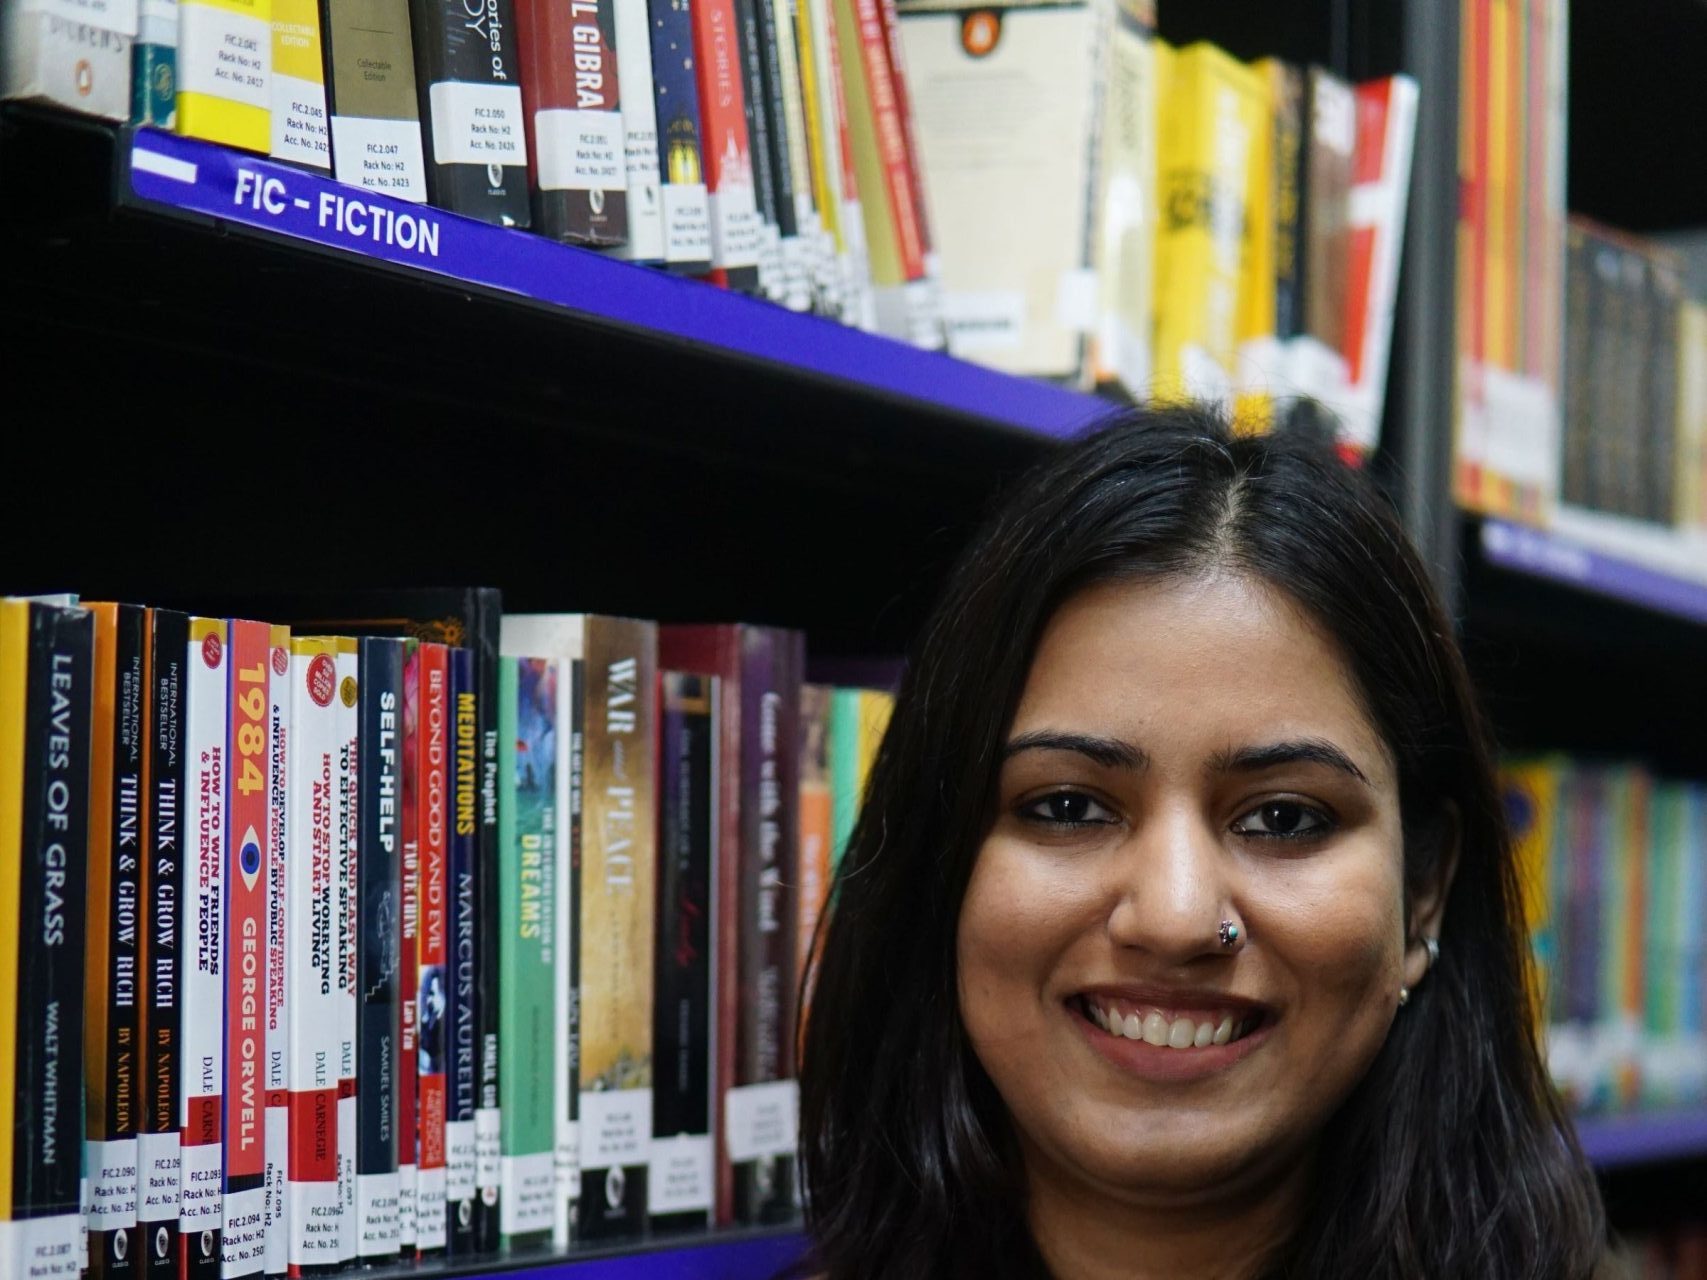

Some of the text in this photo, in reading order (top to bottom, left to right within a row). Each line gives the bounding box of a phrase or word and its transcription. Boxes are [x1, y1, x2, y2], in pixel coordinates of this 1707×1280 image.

[492, 57, 507, 80] of
[572, 26, 604, 109] GIBRA
[234, 168, 285, 215] FIC
[318, 192, 440, 256] FICTION
[362, 176, 376, 186] Acc.
[378, 178, 390, 187] No.
[363, 160, 404, 171] Rack No: H2
[122, 672, 131, 745] BESTSELLER
[130, 656, 140, 763] INTERNATIONAL
[159, 678, 168, 751] BESTSELLER
[168, 662, 177, 768] INTERNATIONAL
[238, 663, 266, 795] 1984
[273, 705, 280, 714] &
[43, 654, 73, 945] LEAVES OF GRASS
[272, 716, 280, 806] INFLUENCE
[280, 766, 286, 788] TO
[380, 692, 395, 852] SELF-HELP
[428, 669, 442, 954] BEYOND GOOD AND EVIL
[457, 693, 476, 836] MEDITATIONS
[482, 730, 497, 825] The Prophet
[606, 658, 636, 898] WAR PEACE
[198, 751, 210, 971] & INFLUENCE PEOPLE
[210, 747, 221, 976] HOW TO WIN FRIENDS
[270, 868, 278, 887] BY
[278, 790, 286, 862] DEVELOP
[312, 781, 322, 968] AND START LIVING
[321, 753, 331, 996] HOW TO STOP WORRYING
[338, 744, 349, 990] TO EFFECTIVE SPEAKING
[348, 737, 358, 998] THE QUICK AND EASY WAY
[116, 773, 138, 1007] THINK & GROW RICH
[156, 778, 176, 1009] THINK & GROW RICH
[270, 890, 278, 946] PUBLIC
[276, 863, 286, 1008] SELF-CONFIDENCE
[520, 834, 542, 939] DREAMS
[241, 917, 257, 1151] GEORGE ORWELL
[458, 873, 473, 1121] MARCUS AURELIU
[42, 1002, 60, 1165] WALT WHITMAN
[116, 1028, 131, 1133] BY NAPOLEON
[156, 1028, 171, 1132] BY NAPOLEON
[202, 1056, 212, 1093] DALE
[271, 1050, 282, 1087] DALE
[315, 1051, 326, 1161] DALE CARNEGIE
[342, 1041, 352, 1076] DALE
[380, 1035, 390, 1142] SAMUEL SMILES
[90, 1204, 124, 1214] Acc. No.
[94, 1187, 114, 1196] Rack
[180, 1206, 212, 1217] Acc. No.
[184, 1190, 203, 1200] Rack
[222, 1230, 264, 1246] Rack No: H2
[228, 1214, 260, 1228] FIC.2.094
[220, 1247, 264, 1263] Acc. No. 250
